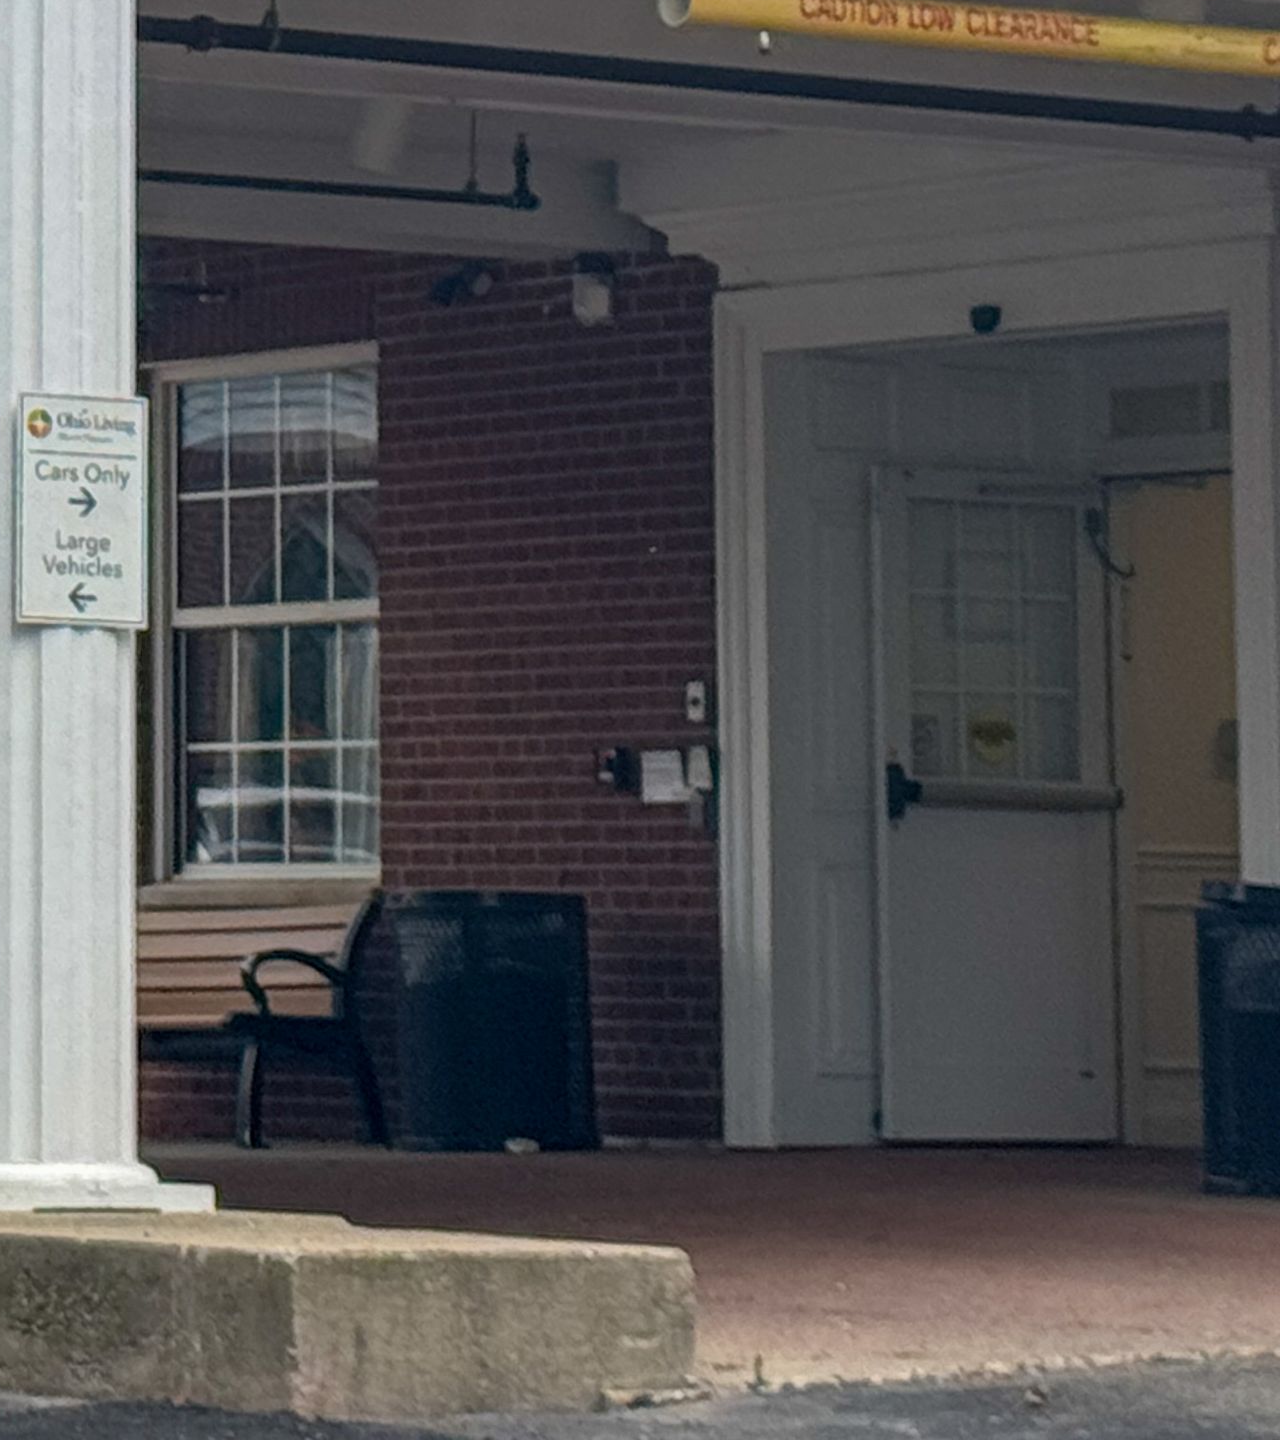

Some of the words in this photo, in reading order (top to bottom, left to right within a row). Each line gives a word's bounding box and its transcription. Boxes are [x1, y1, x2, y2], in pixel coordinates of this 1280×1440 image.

[908, 3, 954, 32] LOW
[966, 9, 1100, 47] CLEARANCE
[56, 408, 92, 429] Ohio
[93, 413, 137, 437] Living
[34, 460, 79, 483] Cars
[83, 462, 130, 490] Only
[55, 529, 111, 558] Large
[42, 554, 123, 579] Vehicles
